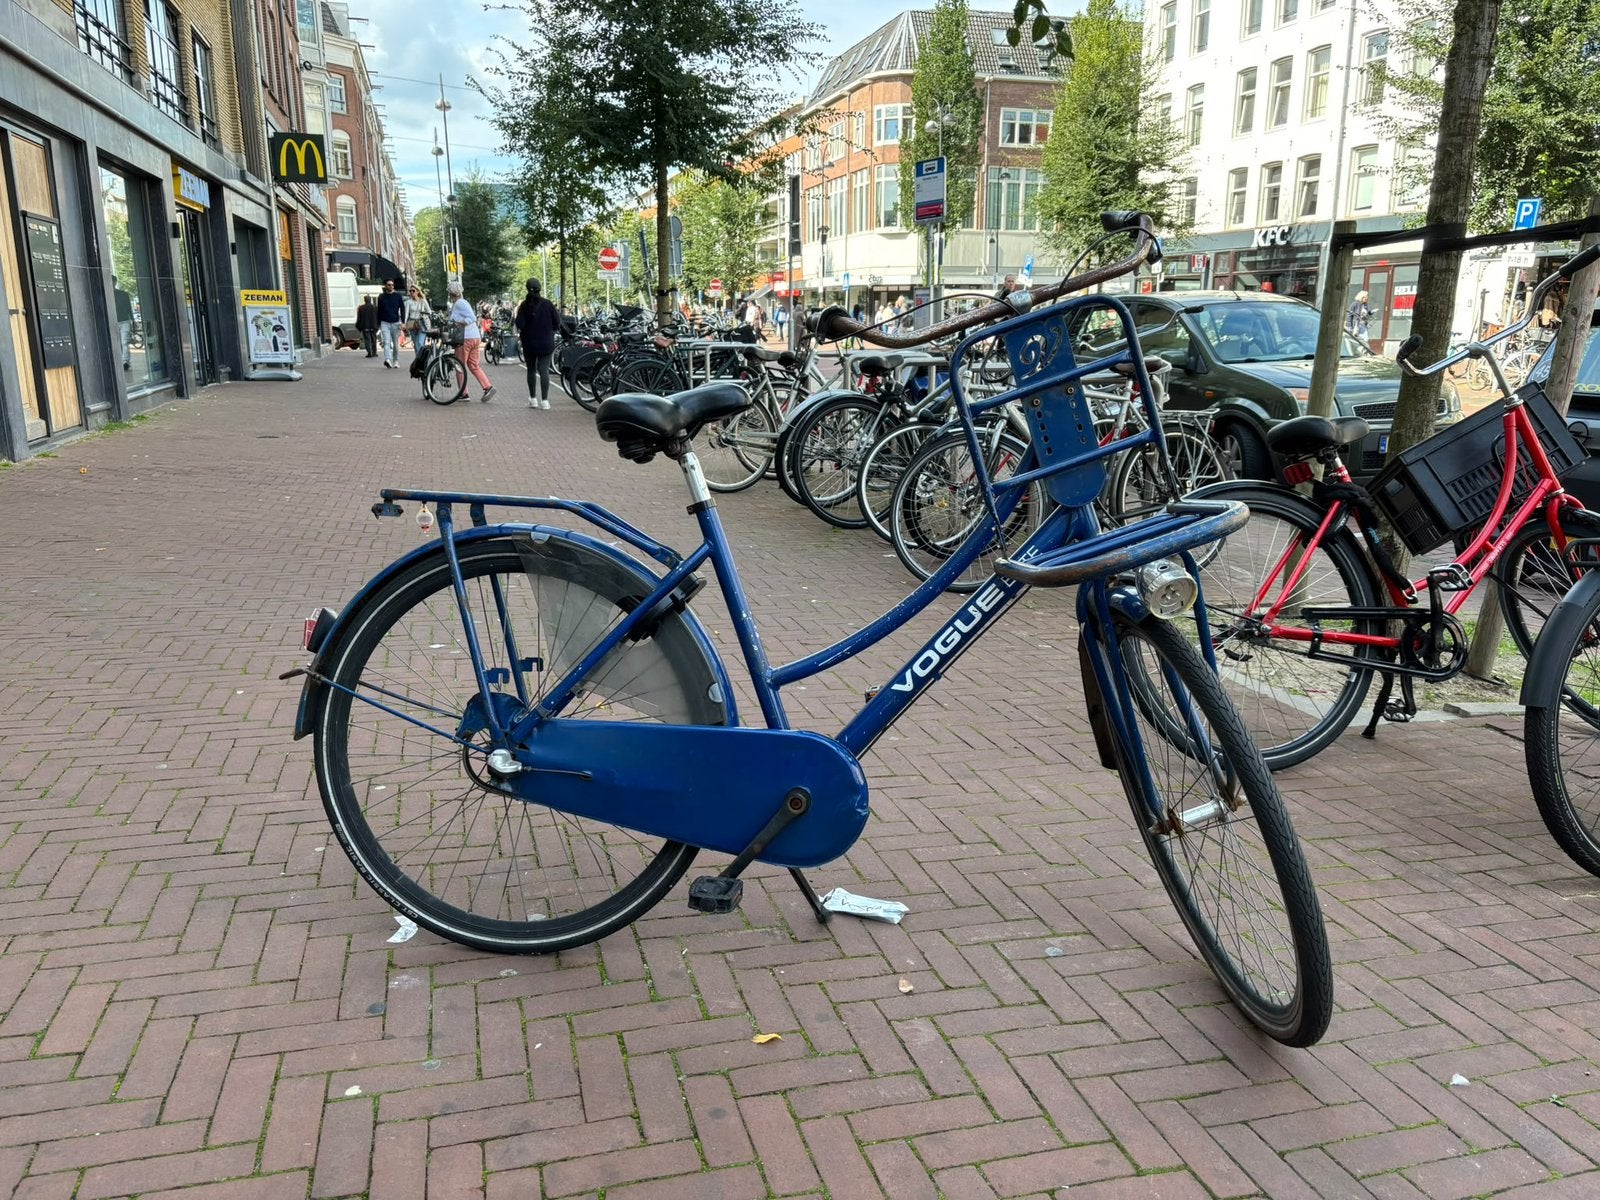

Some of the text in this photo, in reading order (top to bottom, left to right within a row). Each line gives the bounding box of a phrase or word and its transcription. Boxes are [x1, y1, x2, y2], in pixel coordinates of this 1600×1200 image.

[1519, 203, 1534, 223] P
[1251, 226, 1289, 248] KFC
[244, 294, 283, 302] ZEEMAN
[891, 583, 1005, 692] VOGUE
[346, 846, 367, 874] BASIC
[367, 873, 402, 908] CLASSIC
